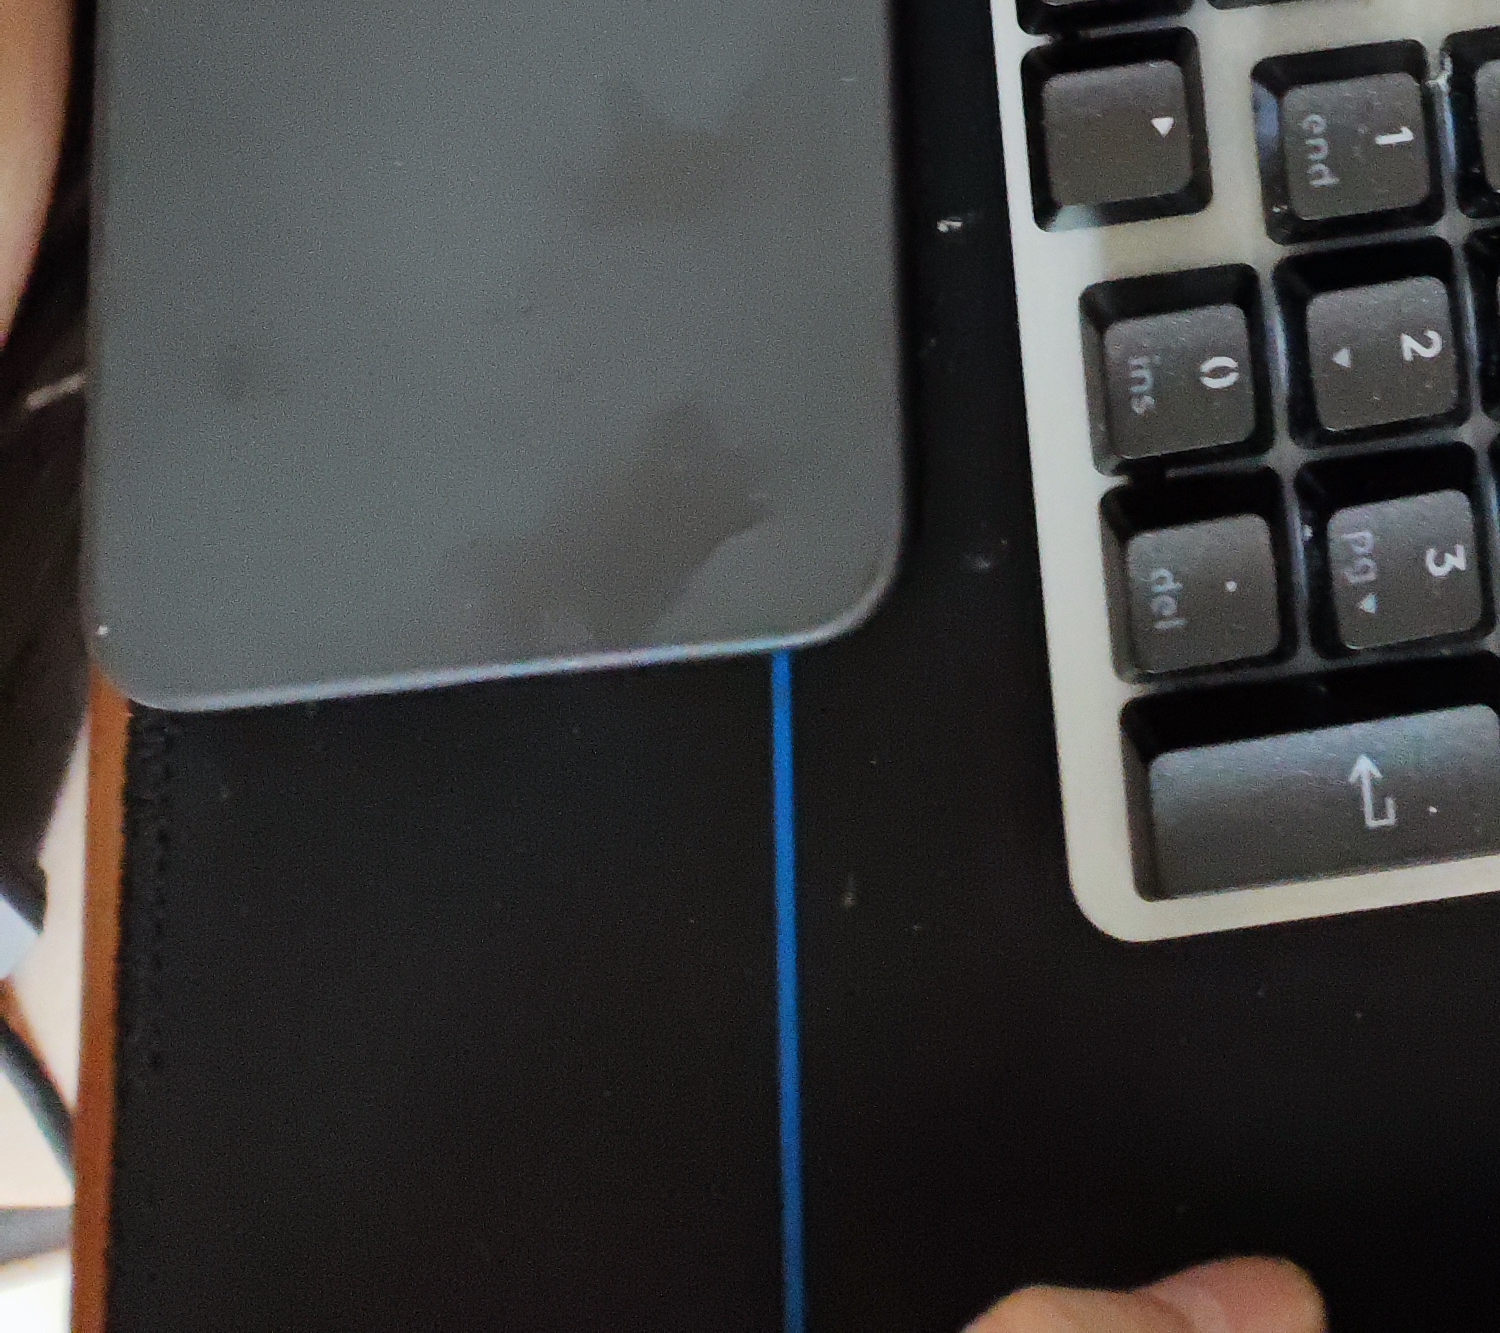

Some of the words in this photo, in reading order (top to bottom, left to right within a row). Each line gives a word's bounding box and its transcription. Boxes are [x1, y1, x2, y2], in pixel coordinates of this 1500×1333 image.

[1299, 113, 1339, 187] end
[1375, 126, 1414, 145] 1
[1400, 329, 1442, 361] 2
[1127, 354, 1161, 415] ins
[1425, 544, 1467, 577] 3
[1149, 568, 1183, 630] del
